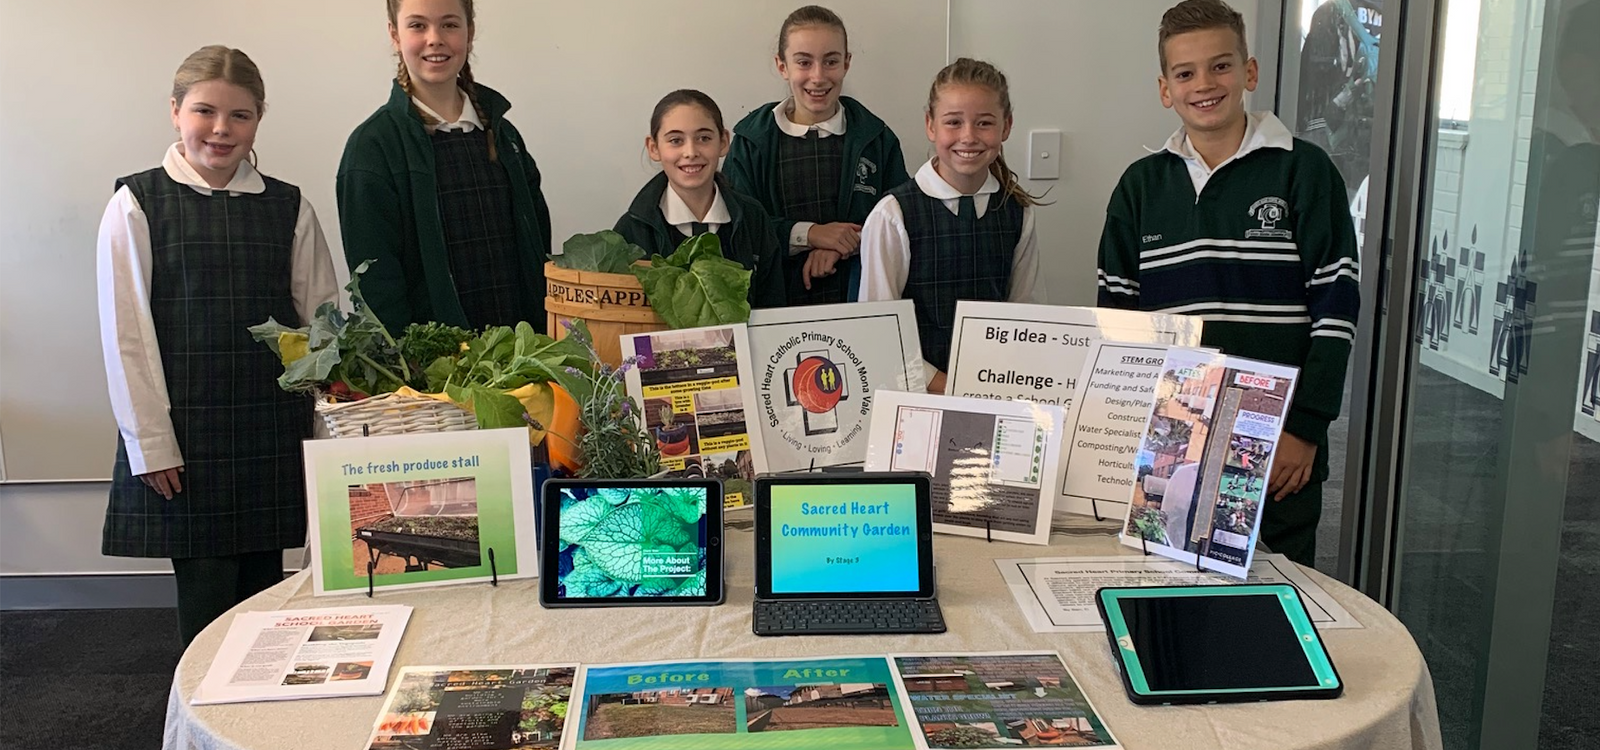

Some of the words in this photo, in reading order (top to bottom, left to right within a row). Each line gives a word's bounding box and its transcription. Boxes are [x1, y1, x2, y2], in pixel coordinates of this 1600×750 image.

[1141, 232, 1163, 244] Ethan
[801, 331, 836, 347] Primary
[985, 326, 1009, 344] Big
[1013, 328, 1047, 344] Idea
[1061, 333, 1090, 348] Sust
[770, 335, 801, 365] Catholic
[836, 338, 863, 367] School
[1121, 355, 1145, 364] STEM
[1145, 357, 1164, 366] GRO
[761, 364, 776, 391] Heart
[857, 366, 870, 394] Mona
[977, 368, 1054, 389] Challenge
[1094, 367, 1135, 379] Marketing
[1135, 370, 1152, 379] and
[1090, 381, 1121, 392] Funding
[1122, 383, 1138, 392] and
[1239, 375, 1270, 388] BEFORE
[860, 396, 872, 416] Vale
[1105, 396, 1152, 408] Design/Plan
[761, 392, 779, 428] Sacred
[1242, 411, 1275, 423] PROGRESS
[1079, 424, 1102, 434] Water
[782, 431, 803, 451] Living
[808, 444, 831, 454] Loving
[836, 423, 862, 448] Learning
[341, 463, 364, 476] The
[366, 460, 400, 474] fresh
[403, 459, 449, 473] produce
[451, 455, 479, 468] stall
[1097, 474, 1134, 487] Technolo
[801, 502, 847, 515] Sacred
[851, 501, 889, 514] Heart
[781, 523, 859, 538] Community
[862, 522, 910, 536] Garden
[643, 556, 664, 564] More
[665, 556, 690, 564] About
[836, 556, 853, 564] Stage
[643, 564, 659, 572] The
[660, 564, 691, 574] Project:
[627, 672, 710, 686] Before
[783, 668, 850, 679] After
